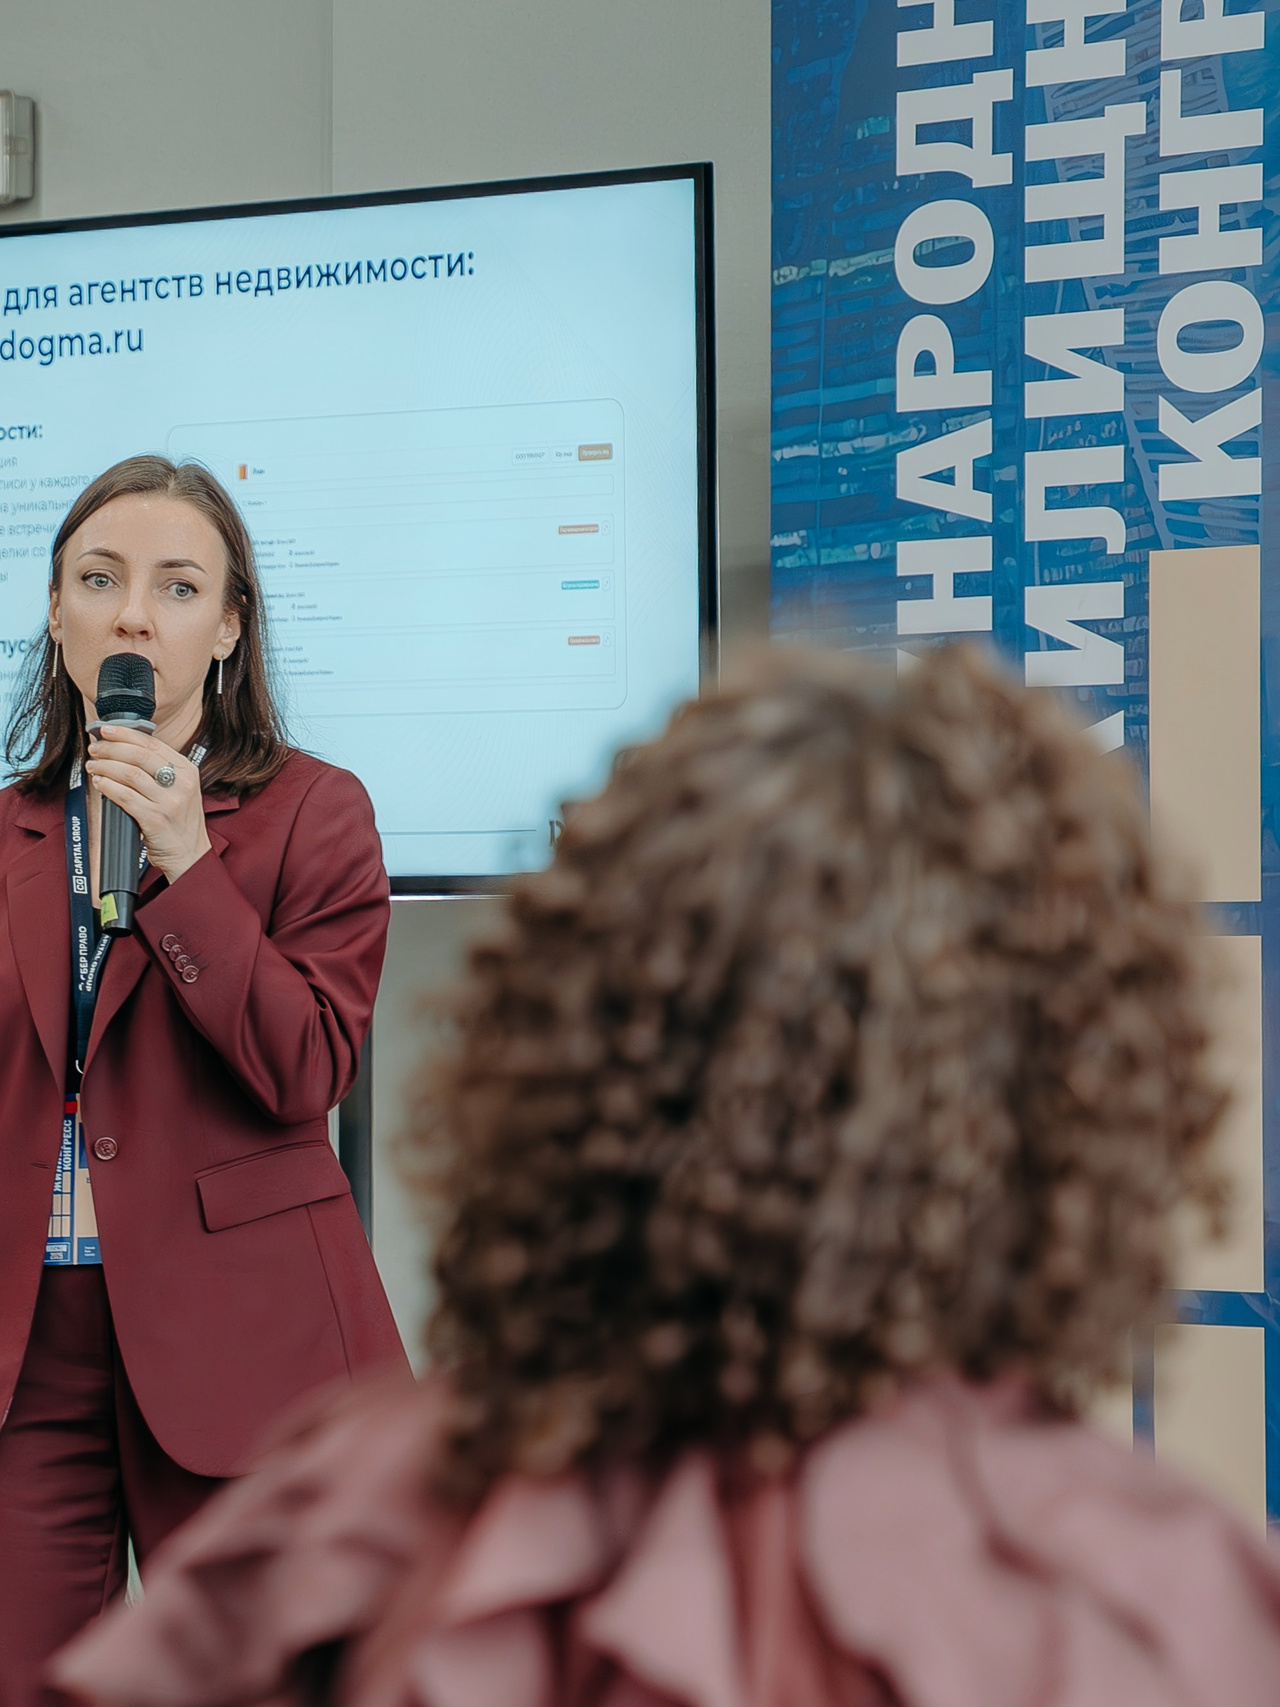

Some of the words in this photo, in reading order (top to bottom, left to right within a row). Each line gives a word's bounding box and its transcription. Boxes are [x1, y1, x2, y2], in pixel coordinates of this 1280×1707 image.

[1157, 0, 1265, 502] КОНГР
[3, 284, 58, 316] для
[68, 273, 205, 307] агентств
[216, 250, 475, 297] недвижимости:
[895, 0, 1014, 680] НАРОДН
[1024, 0, 1147, 757] ИЛИЩН
[29, 478, 37, 491] у
[40, 475, 90, 488] каждого
[31, 546, 47, 557] со
[72, 816, 81, 842] GROUP
[72, 843, 84, 875] CAPITAL
[85, 961, 98, 992] GROUP
[62, 1119, 73, 1171] КОНГРЕСС
